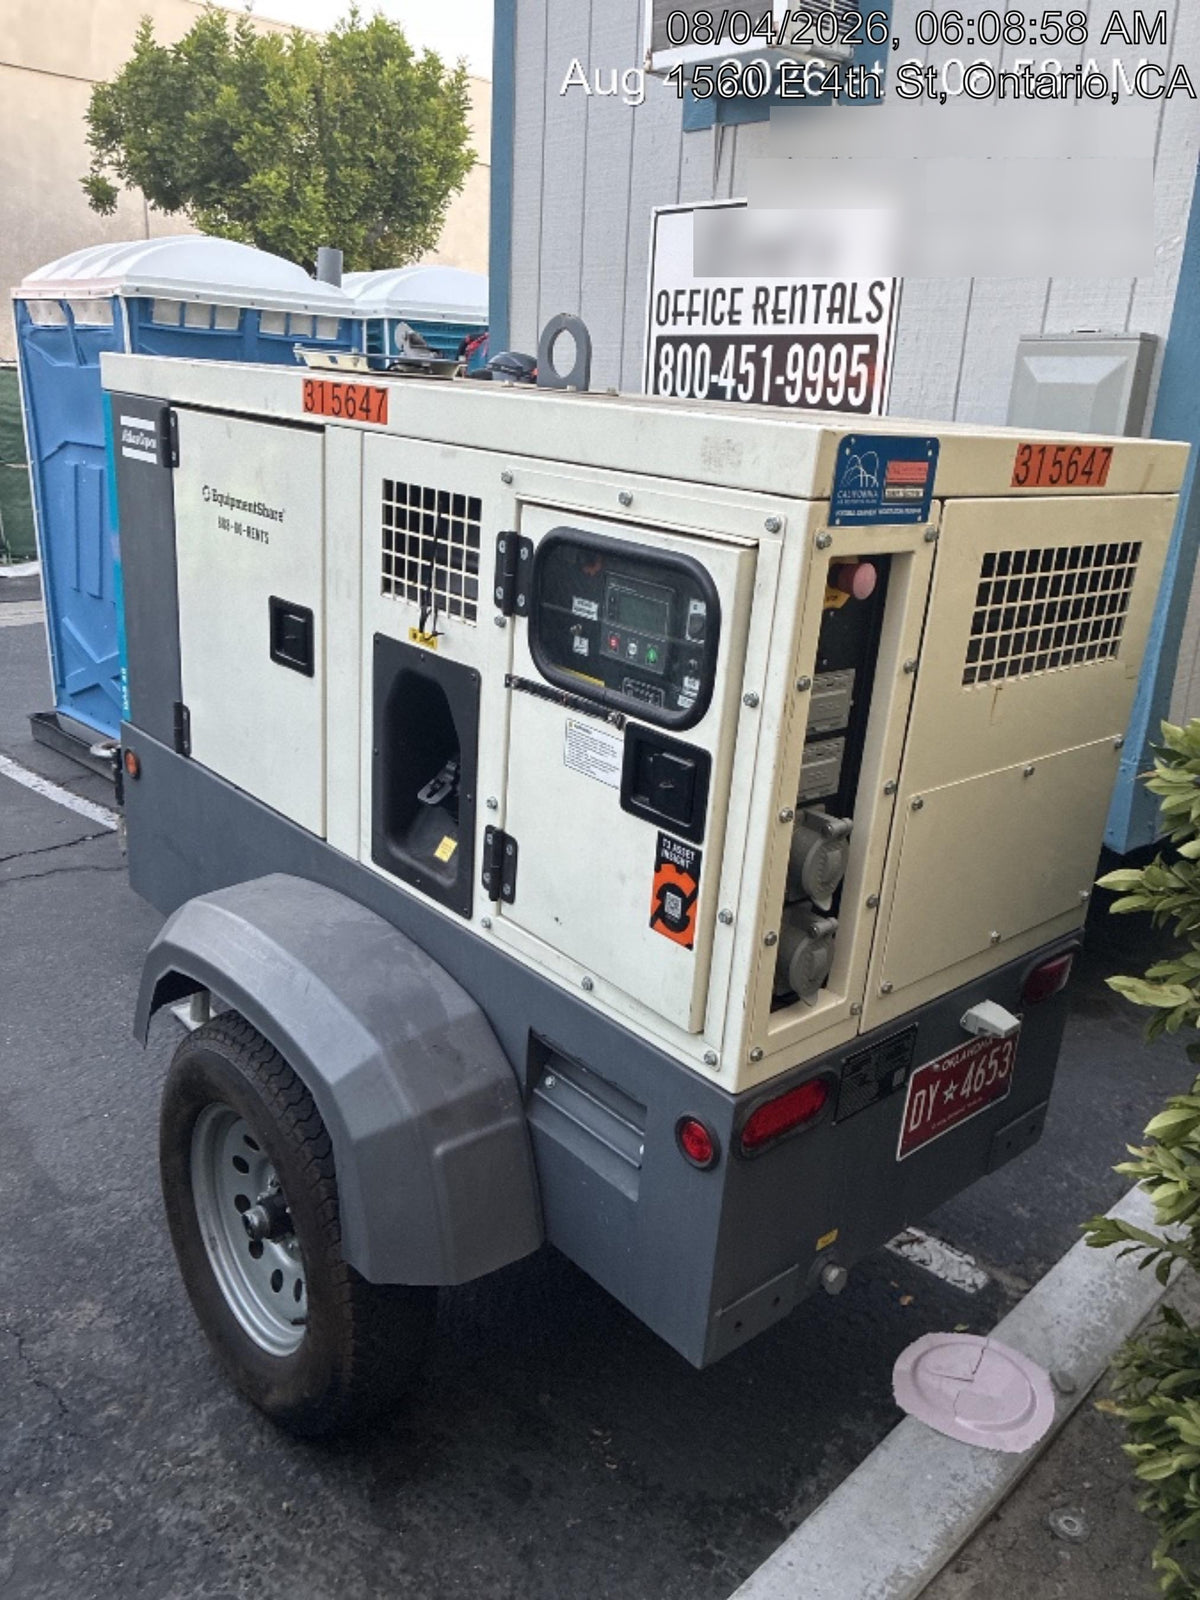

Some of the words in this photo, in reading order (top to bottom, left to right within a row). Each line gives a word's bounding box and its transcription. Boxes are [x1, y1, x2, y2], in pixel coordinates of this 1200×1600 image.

[656, 287, 744, 326] OFFICE
[752, 280, 886, 326] RENTALS
[658, 342, 870, 406] 800-451-9995
[304, 380, 388, 421] 315647
[1015, 444, 1113, 486] 315647
[908, 1080, 941, 1133] DY
[960, 1041, 1013, 1099] 4653
